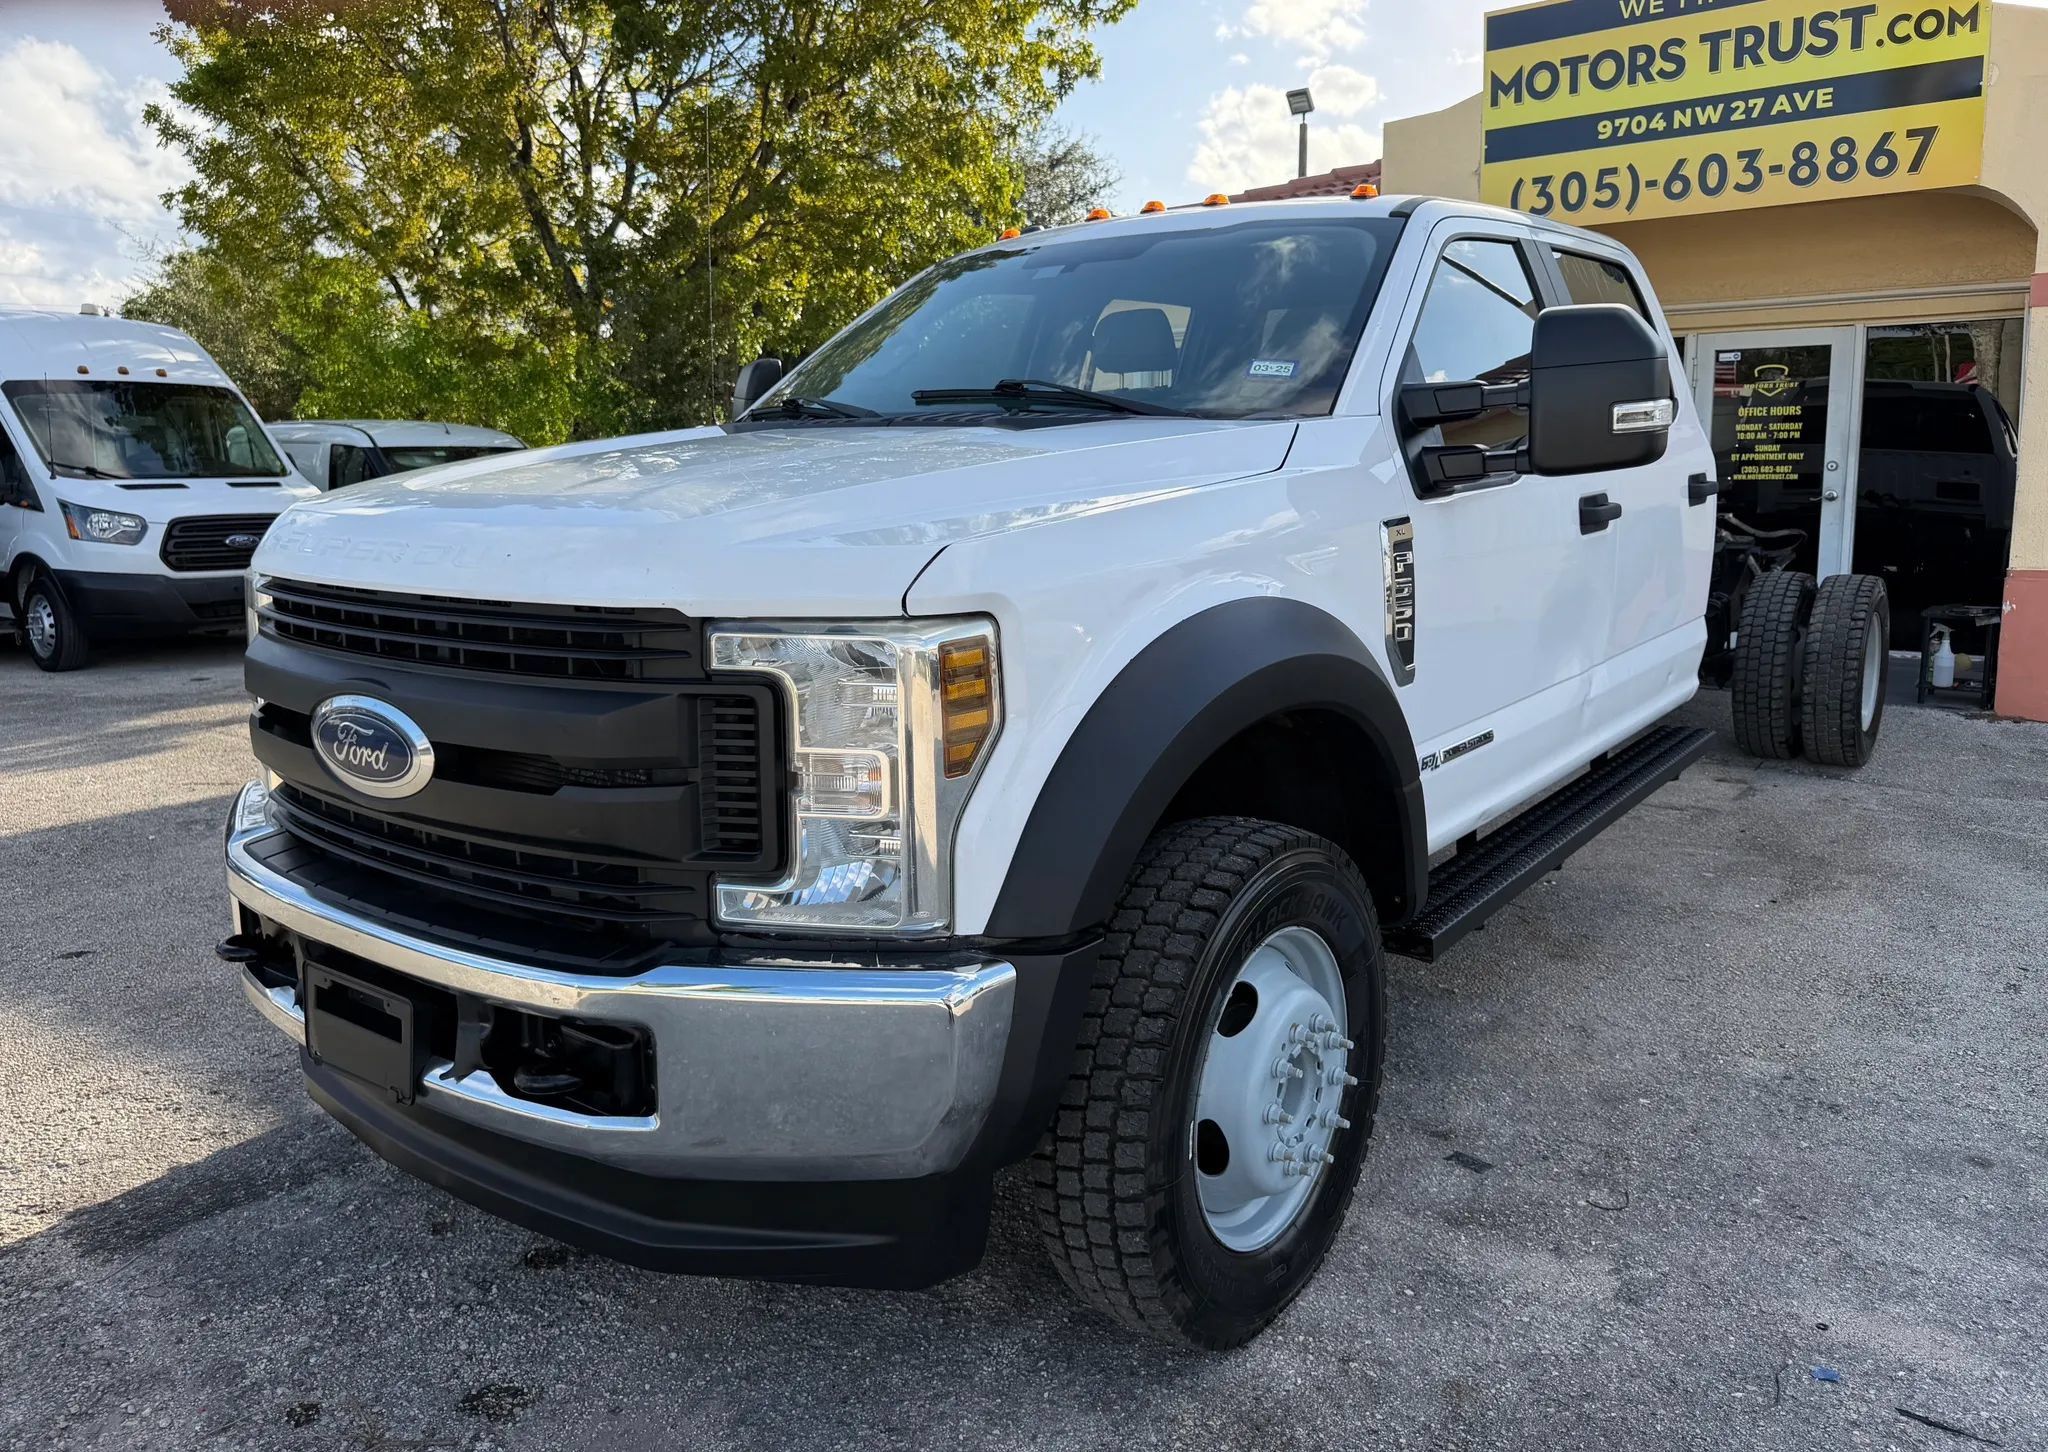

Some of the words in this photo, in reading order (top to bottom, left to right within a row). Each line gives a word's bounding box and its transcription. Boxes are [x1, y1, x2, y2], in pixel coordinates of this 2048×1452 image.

[1619, 0, 1665, 19] WE
[1490, 37, 1687, 109] MOTORS
[1699, 1, 1982, 74] TRUST.COM
[1597, 114, 1667, 140] 9704
[1672, 105, 1726, 129] NW
[1730, 98, 1765, 123] 27
[1770, 88, 1834, 115] AVE
[1510, 126, 1940, 216] (305)-603-8867
[1738, 406, 1768, 417] OFFICE
[1770, 405, 1802, 416] HOURS
[1735, 423, 1763, 431] MONDAY
[1768, 422, 1803, 430] SATURDAY
[1737, 432, 1755, 440] 10:00
[1773, 431, 1788, 439] 7:00
[1789, 431, 1801, 439] PM
[1754, 444, 1781, 452] SUNDAY
[1741, 453, 1786, 461] APPOINTMENT
[1787, 452, 1804, 460] ONLY
[1741, 465, 1759, 474] (305)
[333, 721, 389, 772] Ford
